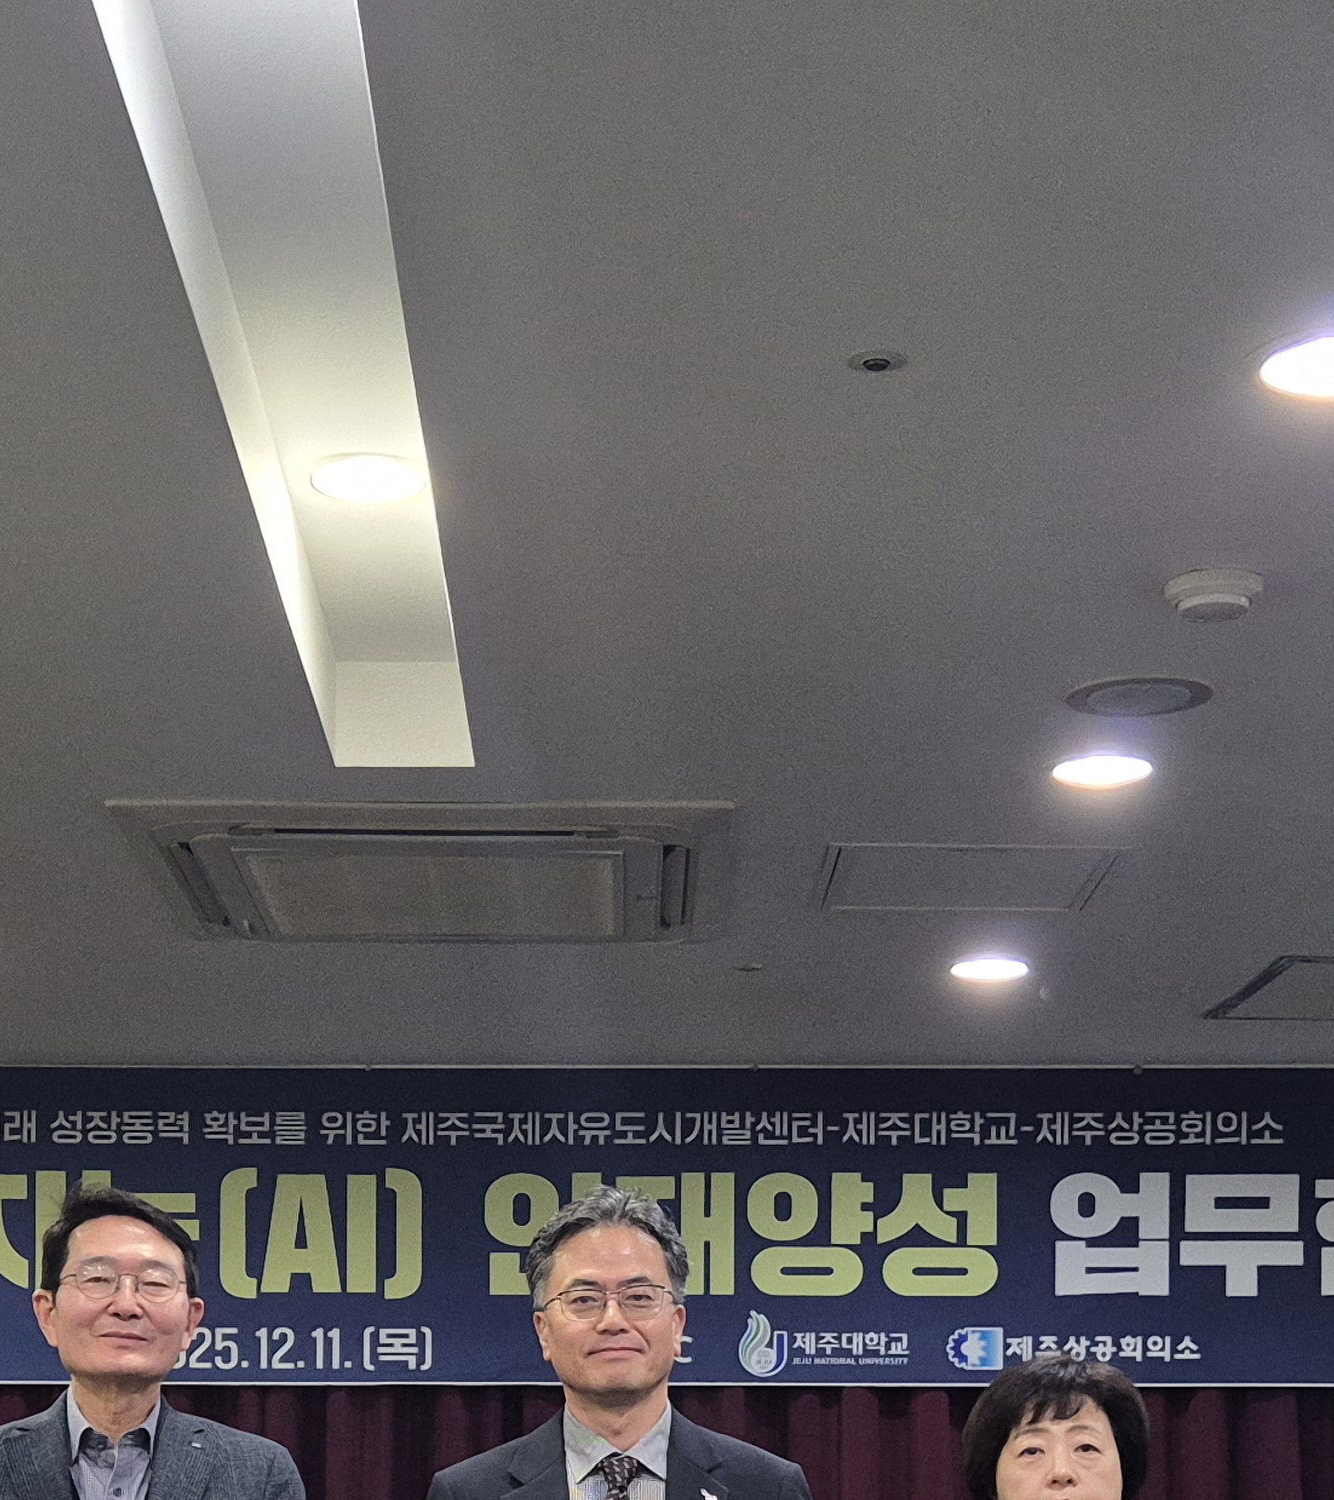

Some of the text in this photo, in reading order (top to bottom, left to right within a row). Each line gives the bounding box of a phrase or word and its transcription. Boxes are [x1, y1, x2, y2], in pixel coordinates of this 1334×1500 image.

[50, 1110, 190, 1145] 성장동력
[203, 1110, 307, 1146] 확보를
[319, 1110, 391, 1146] 위한
[791, 1332, 911, 1356] 제주대학교
[1005, 1335, 1202, 1363] 제주상공회의소
[813, 1357, 857, 1366] NATIONAL
